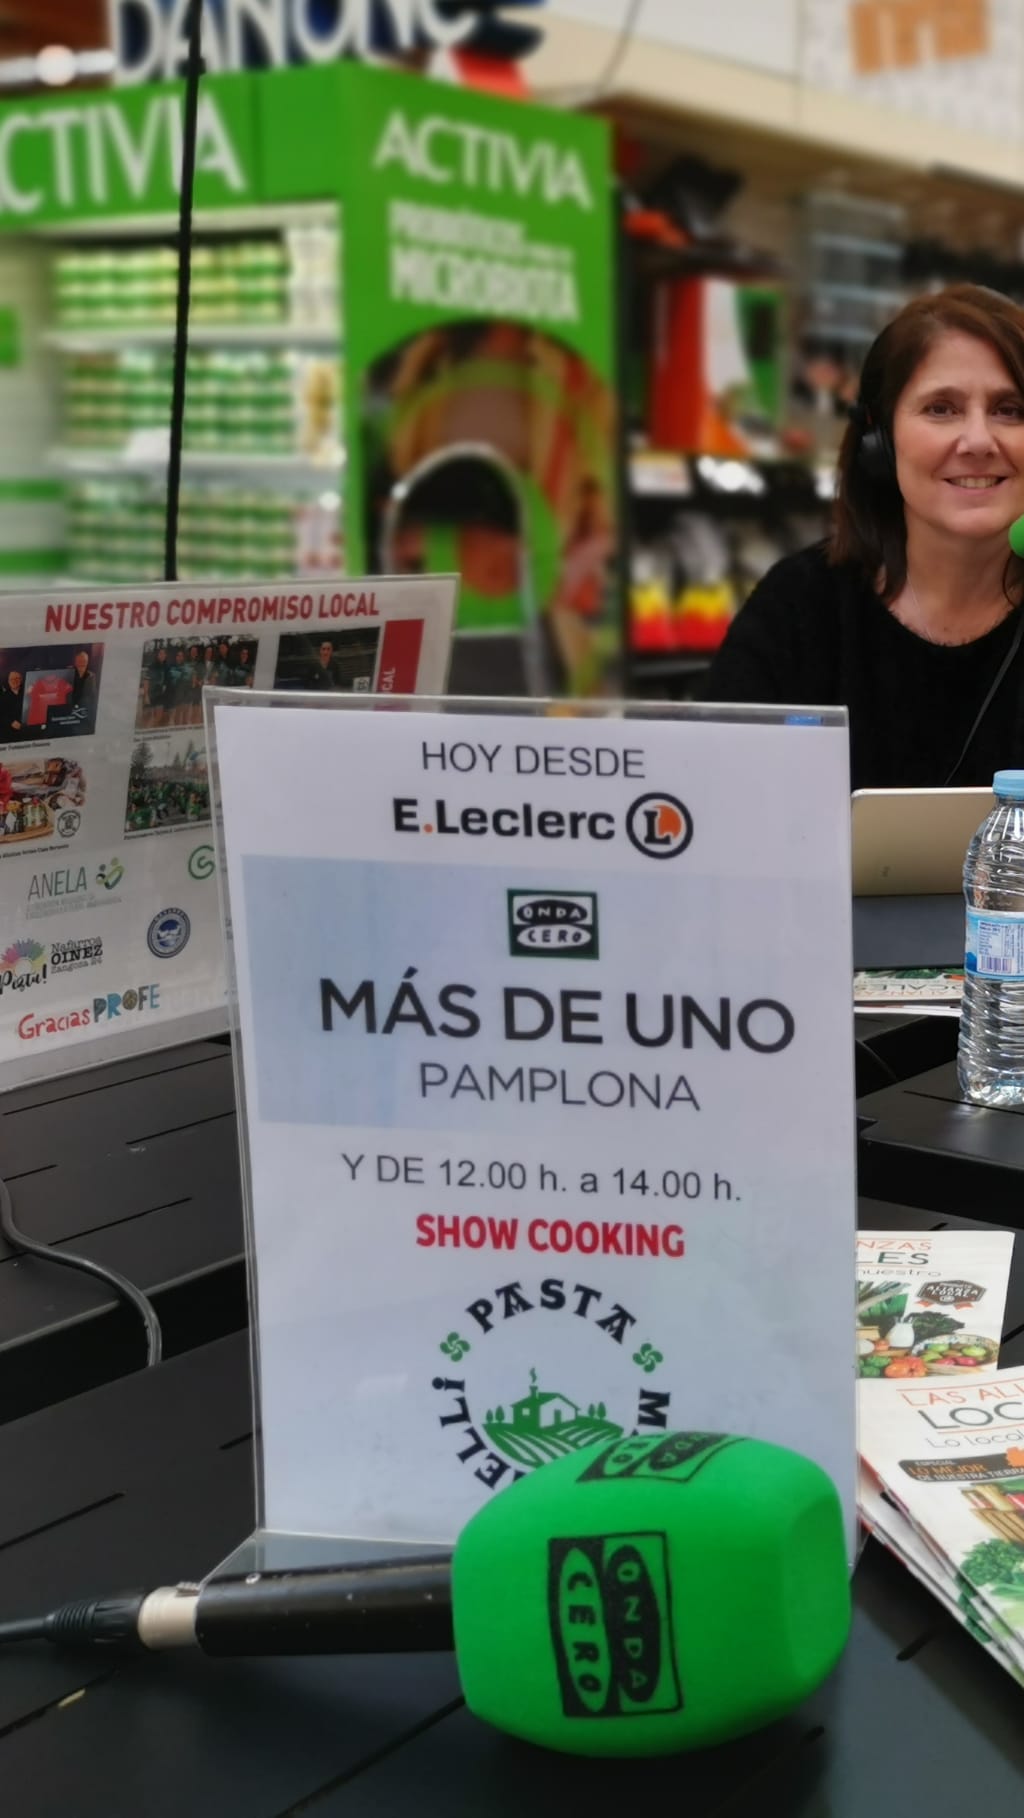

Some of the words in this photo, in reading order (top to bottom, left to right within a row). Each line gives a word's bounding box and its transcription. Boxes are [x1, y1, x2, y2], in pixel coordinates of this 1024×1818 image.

[0, 94, 247, 215] CTIVIA
[372, 109, 594, 212] ACTIVIA
[45, 599, 160, 632] NUESTRO
[166, 593, 313, 626] COMPROMISO
[318, 592, 380, 619] LOCAL
[422, 741, 502, 773] HOY
[515, 745, 646, 779] DESDE
[393, 796, 616, 840] E.Leclerc
[28, 866, 87, 900] ANELA
[522, 906, 582, 919] ONDA
[51, 945, 103, 965] OINEZ
[528, 928, 582, 943] CERO
[18, 1009, 91, 1039] Gracias
[93, 984, 160, 1023] PROFE
[319, 967, 481, 1040] MÁS
[503, 988, 603, 1045] DE
[625, 992, 796, 1054] UNO
[419, 1062, 701, 1112] PAMPLONA
[341, 1153, 365, 1182] Y
[376, 1154, 425, 1185] DE
[439, 1160, 528, 1190] 12.00
[539, 1163, 568, 1193] h.
[579, 1171, 600, 1194] a
[612, 1168, 702, 1199] 14.00
[713, 1172, 742, 1202] h.
[415, 1213, 518, 1251] SHOW
[528, 1218, 686, 1259] COOKING
[856, 1240, 932, 1251] NZAS
[465, 1278, 637, 1345] PASTA
[902, 1390, 966, 1407] LAS
[926, 1437, 961, 1449] Lo
[908, 1466, 929, 1476] LO
[933, 1463, 988, 1475] MEJOR
[567, 1571, 602, 1693] CERO
[616, 1560, 648, 1689] ONDA
